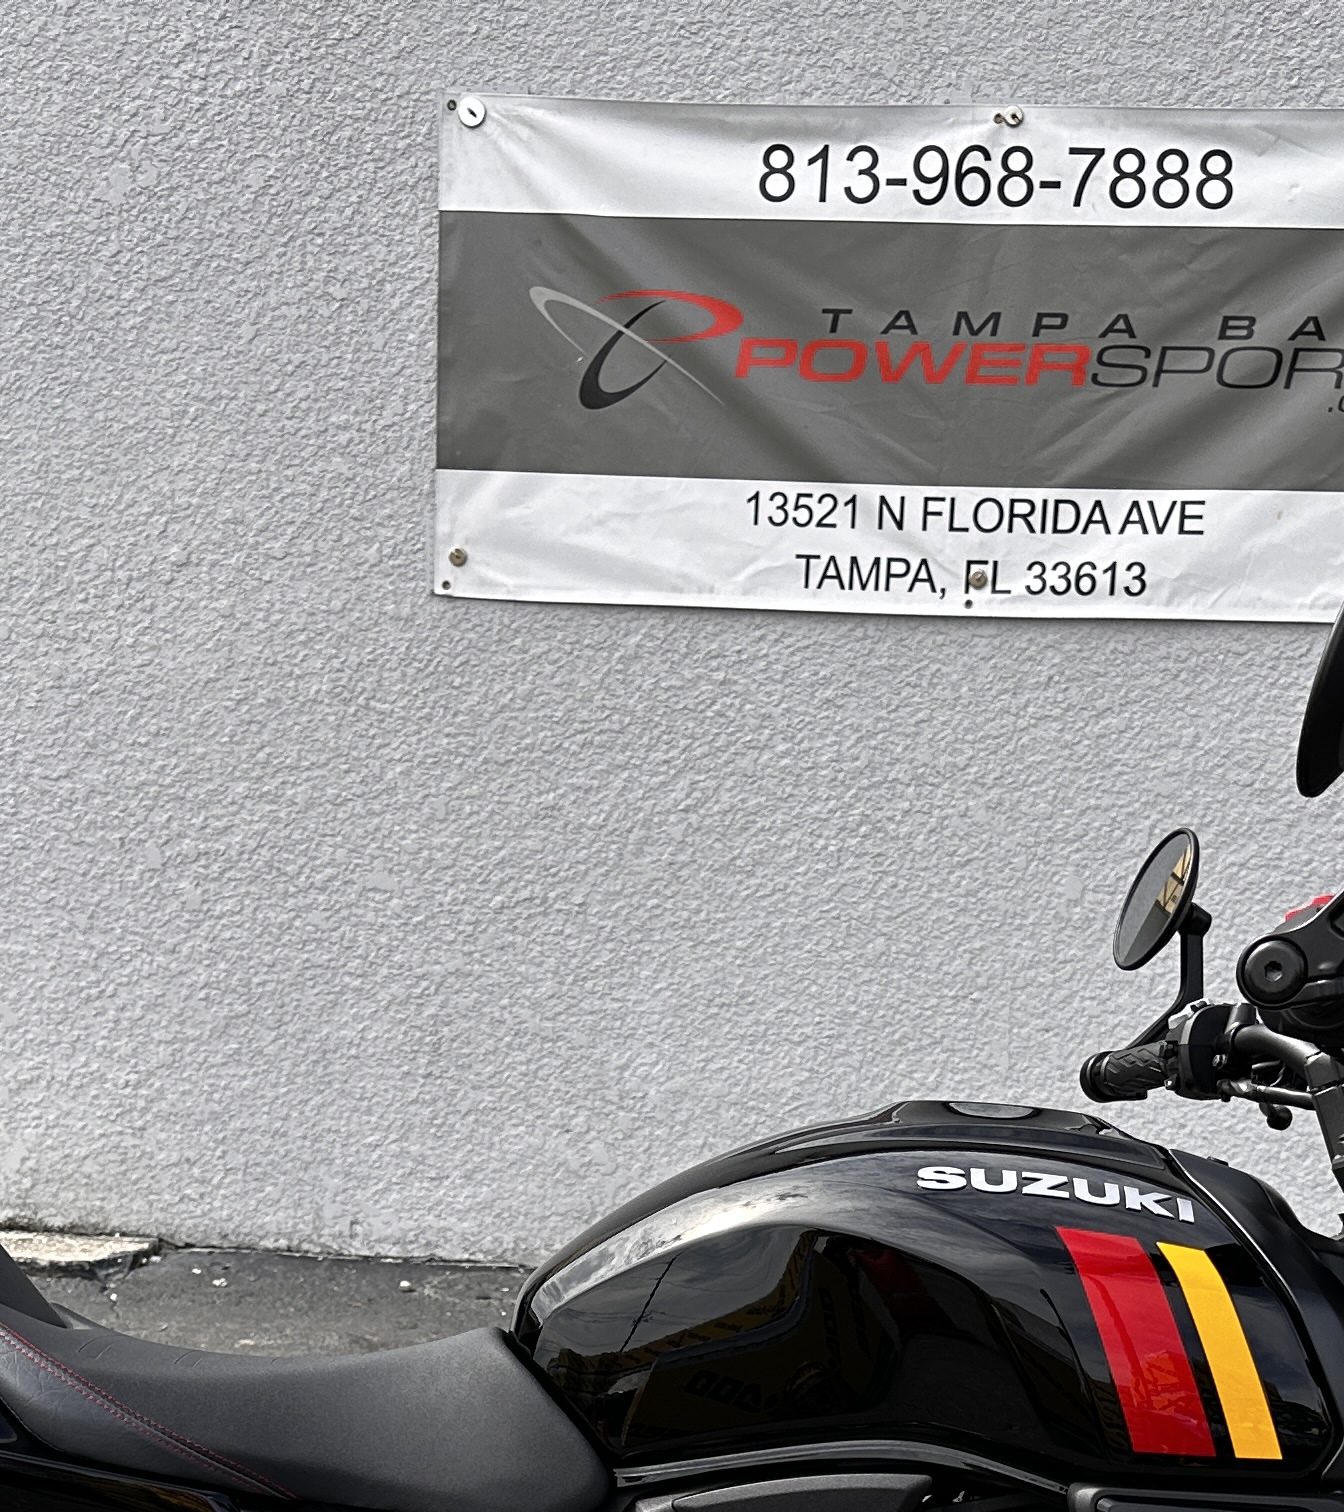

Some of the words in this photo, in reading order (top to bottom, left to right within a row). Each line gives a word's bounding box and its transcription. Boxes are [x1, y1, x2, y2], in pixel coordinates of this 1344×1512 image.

[758, 143, 1234, 210] 813-968-7888
[821, 307, 1138, 339] TAMPA
[746, 490, 857, 529] 13521
[877, 496, 906, 532] N
[922, 497, 1111, 536] FLORIDA
[1118, 500, 1206, 536] AVE
[795, 554, 947, 599] TAMPA,
[964, 560, 1011, 595] FL
[1025, 560, 1147, 597] 33613
[916, 1164, 1196, 1224] SUZUKI
